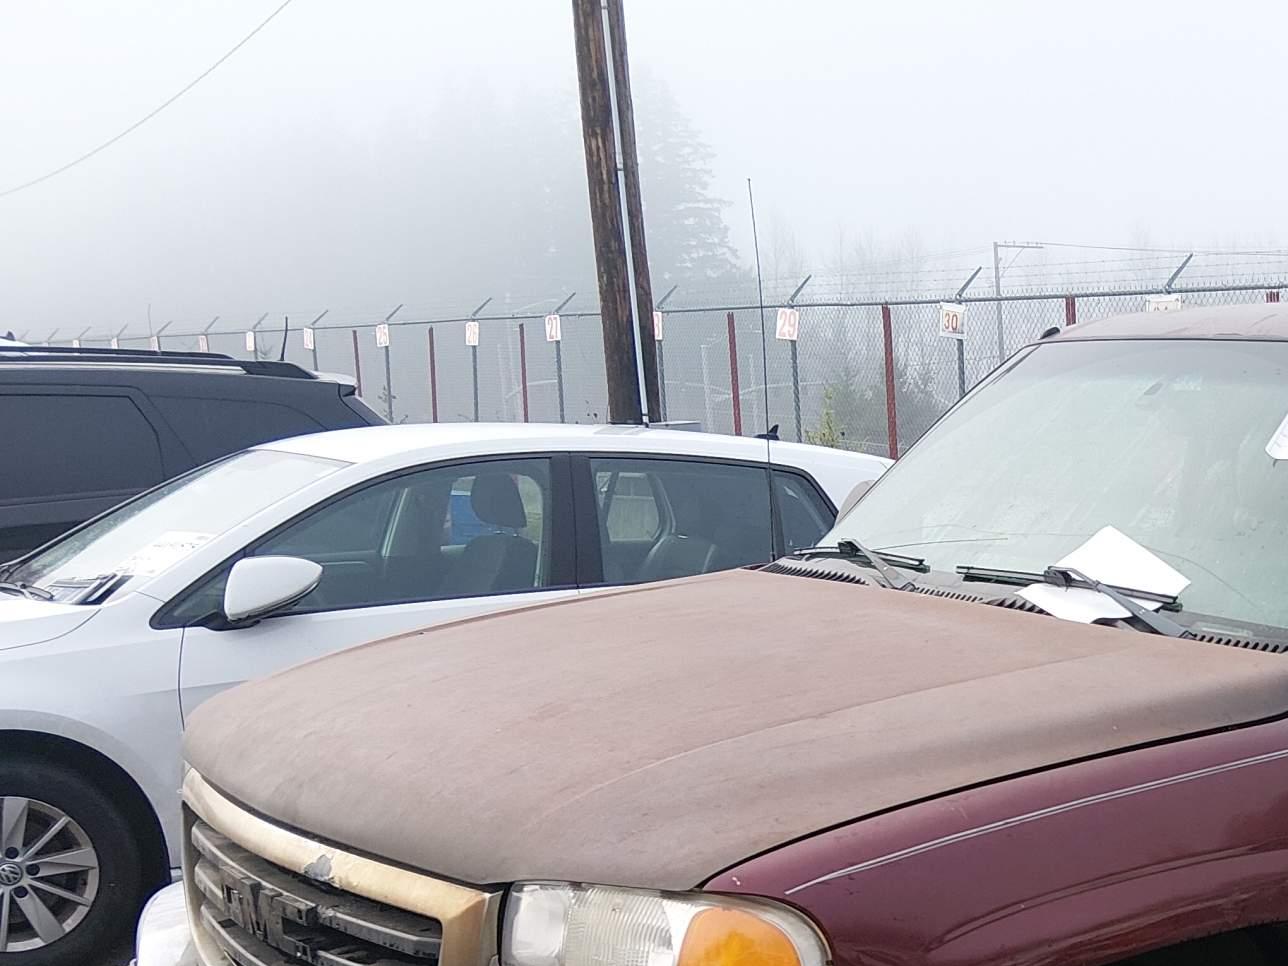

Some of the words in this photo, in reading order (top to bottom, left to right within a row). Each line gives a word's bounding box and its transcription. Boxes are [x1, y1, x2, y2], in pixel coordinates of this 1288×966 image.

[546, 315, 559, 341] 27
[778, 310, 798, 338] 29
[943, 312, 960, 331] 30
